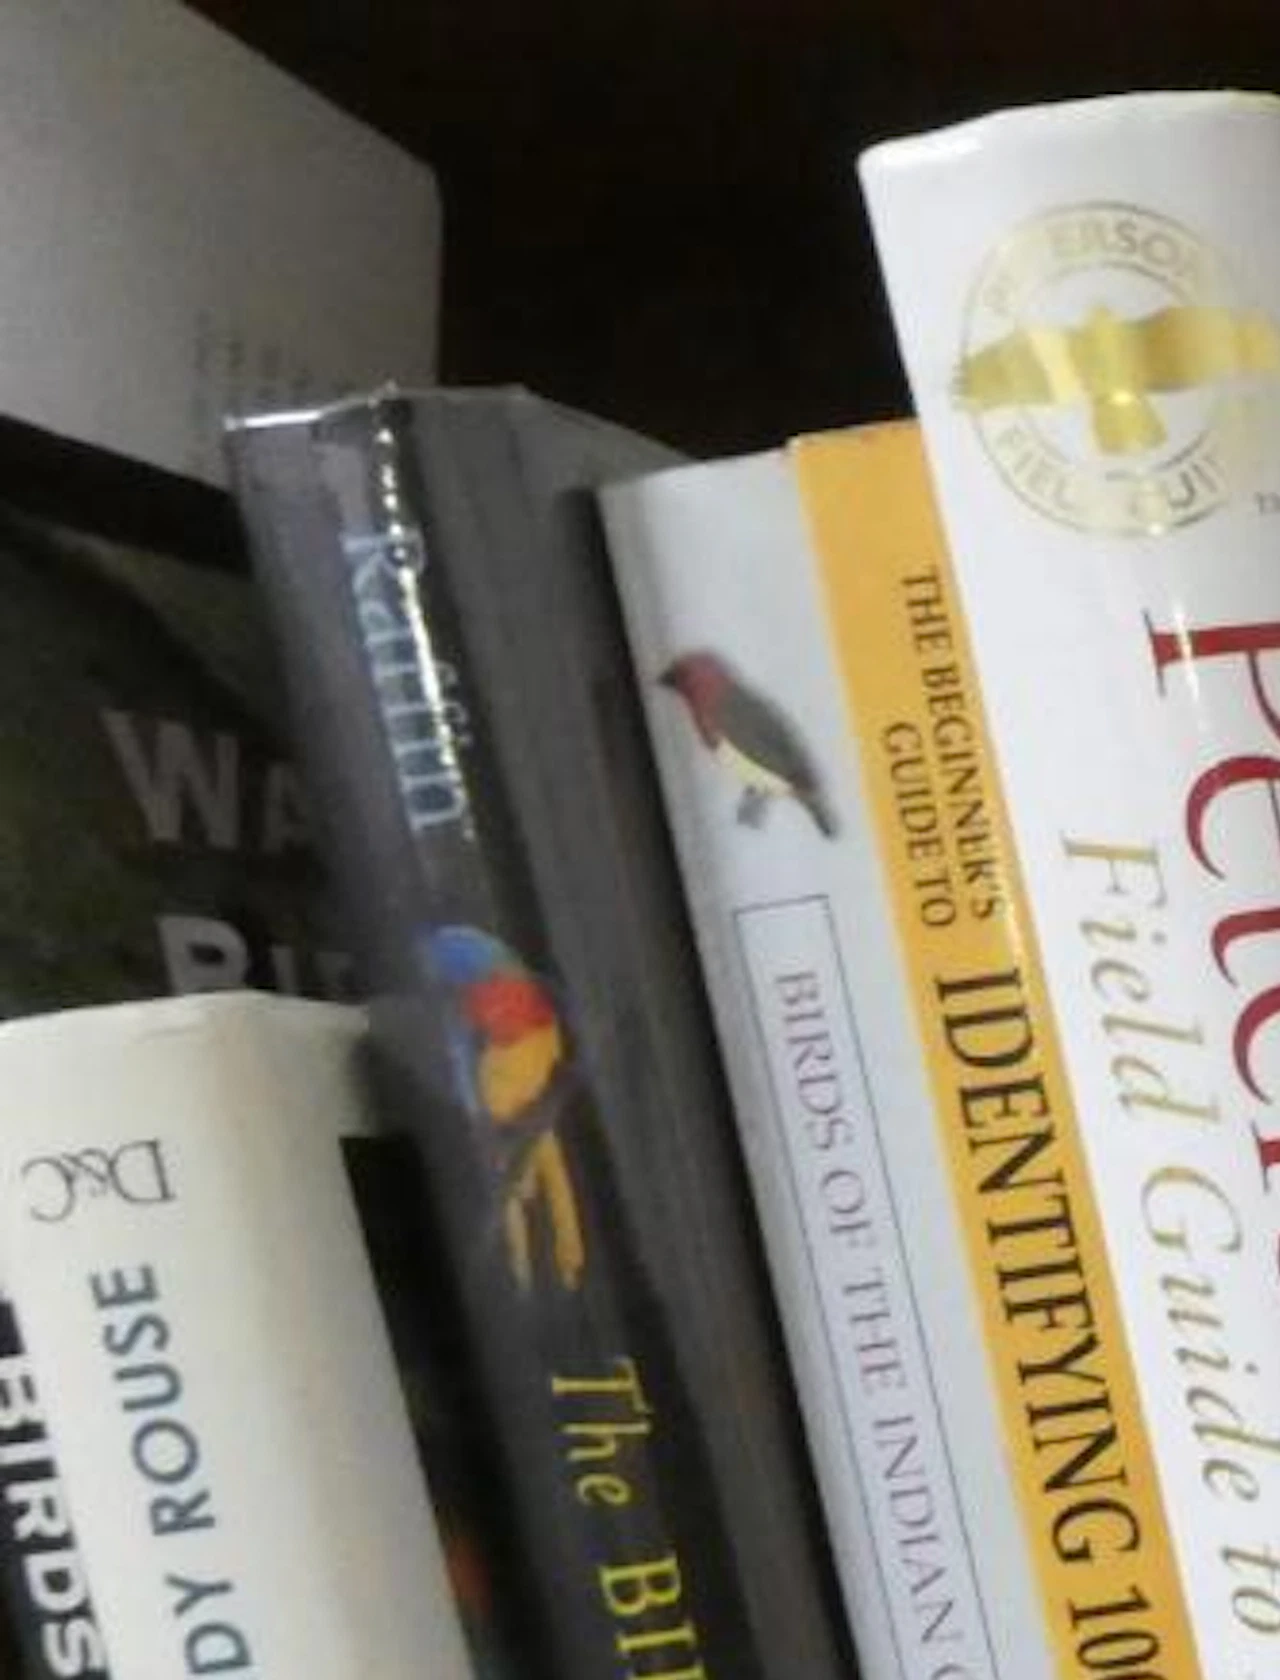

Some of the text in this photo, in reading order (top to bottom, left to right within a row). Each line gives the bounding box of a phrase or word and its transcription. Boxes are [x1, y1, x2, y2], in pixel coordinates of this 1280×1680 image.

[882, 721, 957, 928] GUIDE TO
[901, 565, 996, 922] THE BEGINNER'S
[775, 971, 854, 1155] BIRDS
[1059, 829, 1221, 1131] Field
[823, 1167, 874, 1252] OF
[936, 967, 1142, 1564] IDENTIFYING
[90, 1265, 217, 1536] ROUSE
[551, 1356, 654, 1505] The
[845, 1269, 906, 1392] THE
[0, 1354, 101, 1679] BIRDS
[872, 1414, 956, 1645] INDIAN
